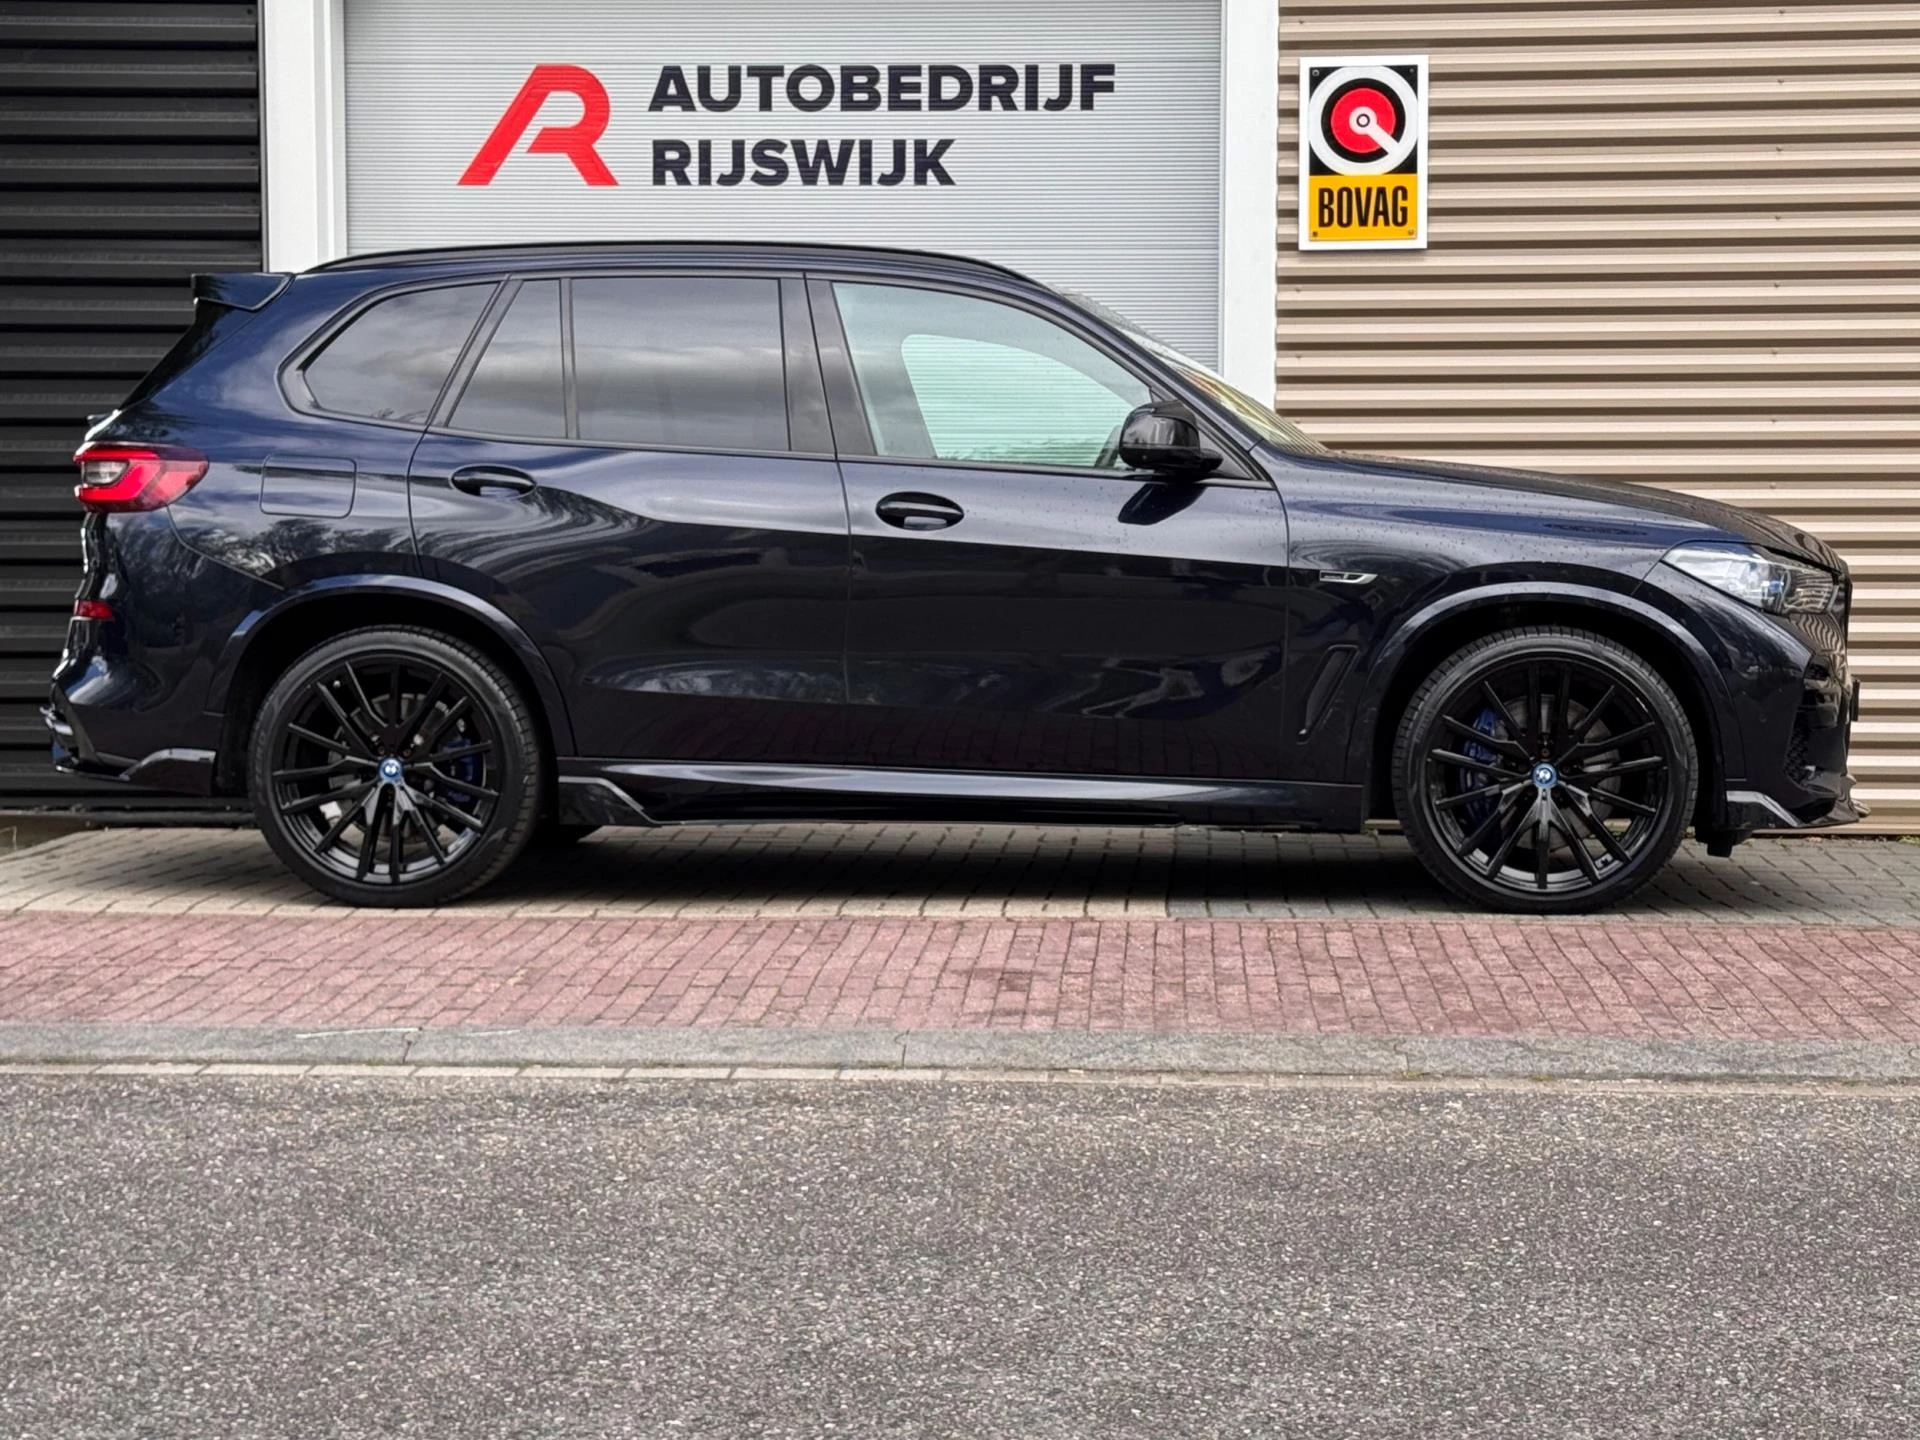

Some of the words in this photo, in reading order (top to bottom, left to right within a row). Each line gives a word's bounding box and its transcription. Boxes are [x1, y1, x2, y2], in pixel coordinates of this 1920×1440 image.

[648, 64, 1116, 113] AUTOBEDRIJF
[652, 139, 956, 187] RIJSWIJK
[1318, 185, 1409, 228] BOVAG
